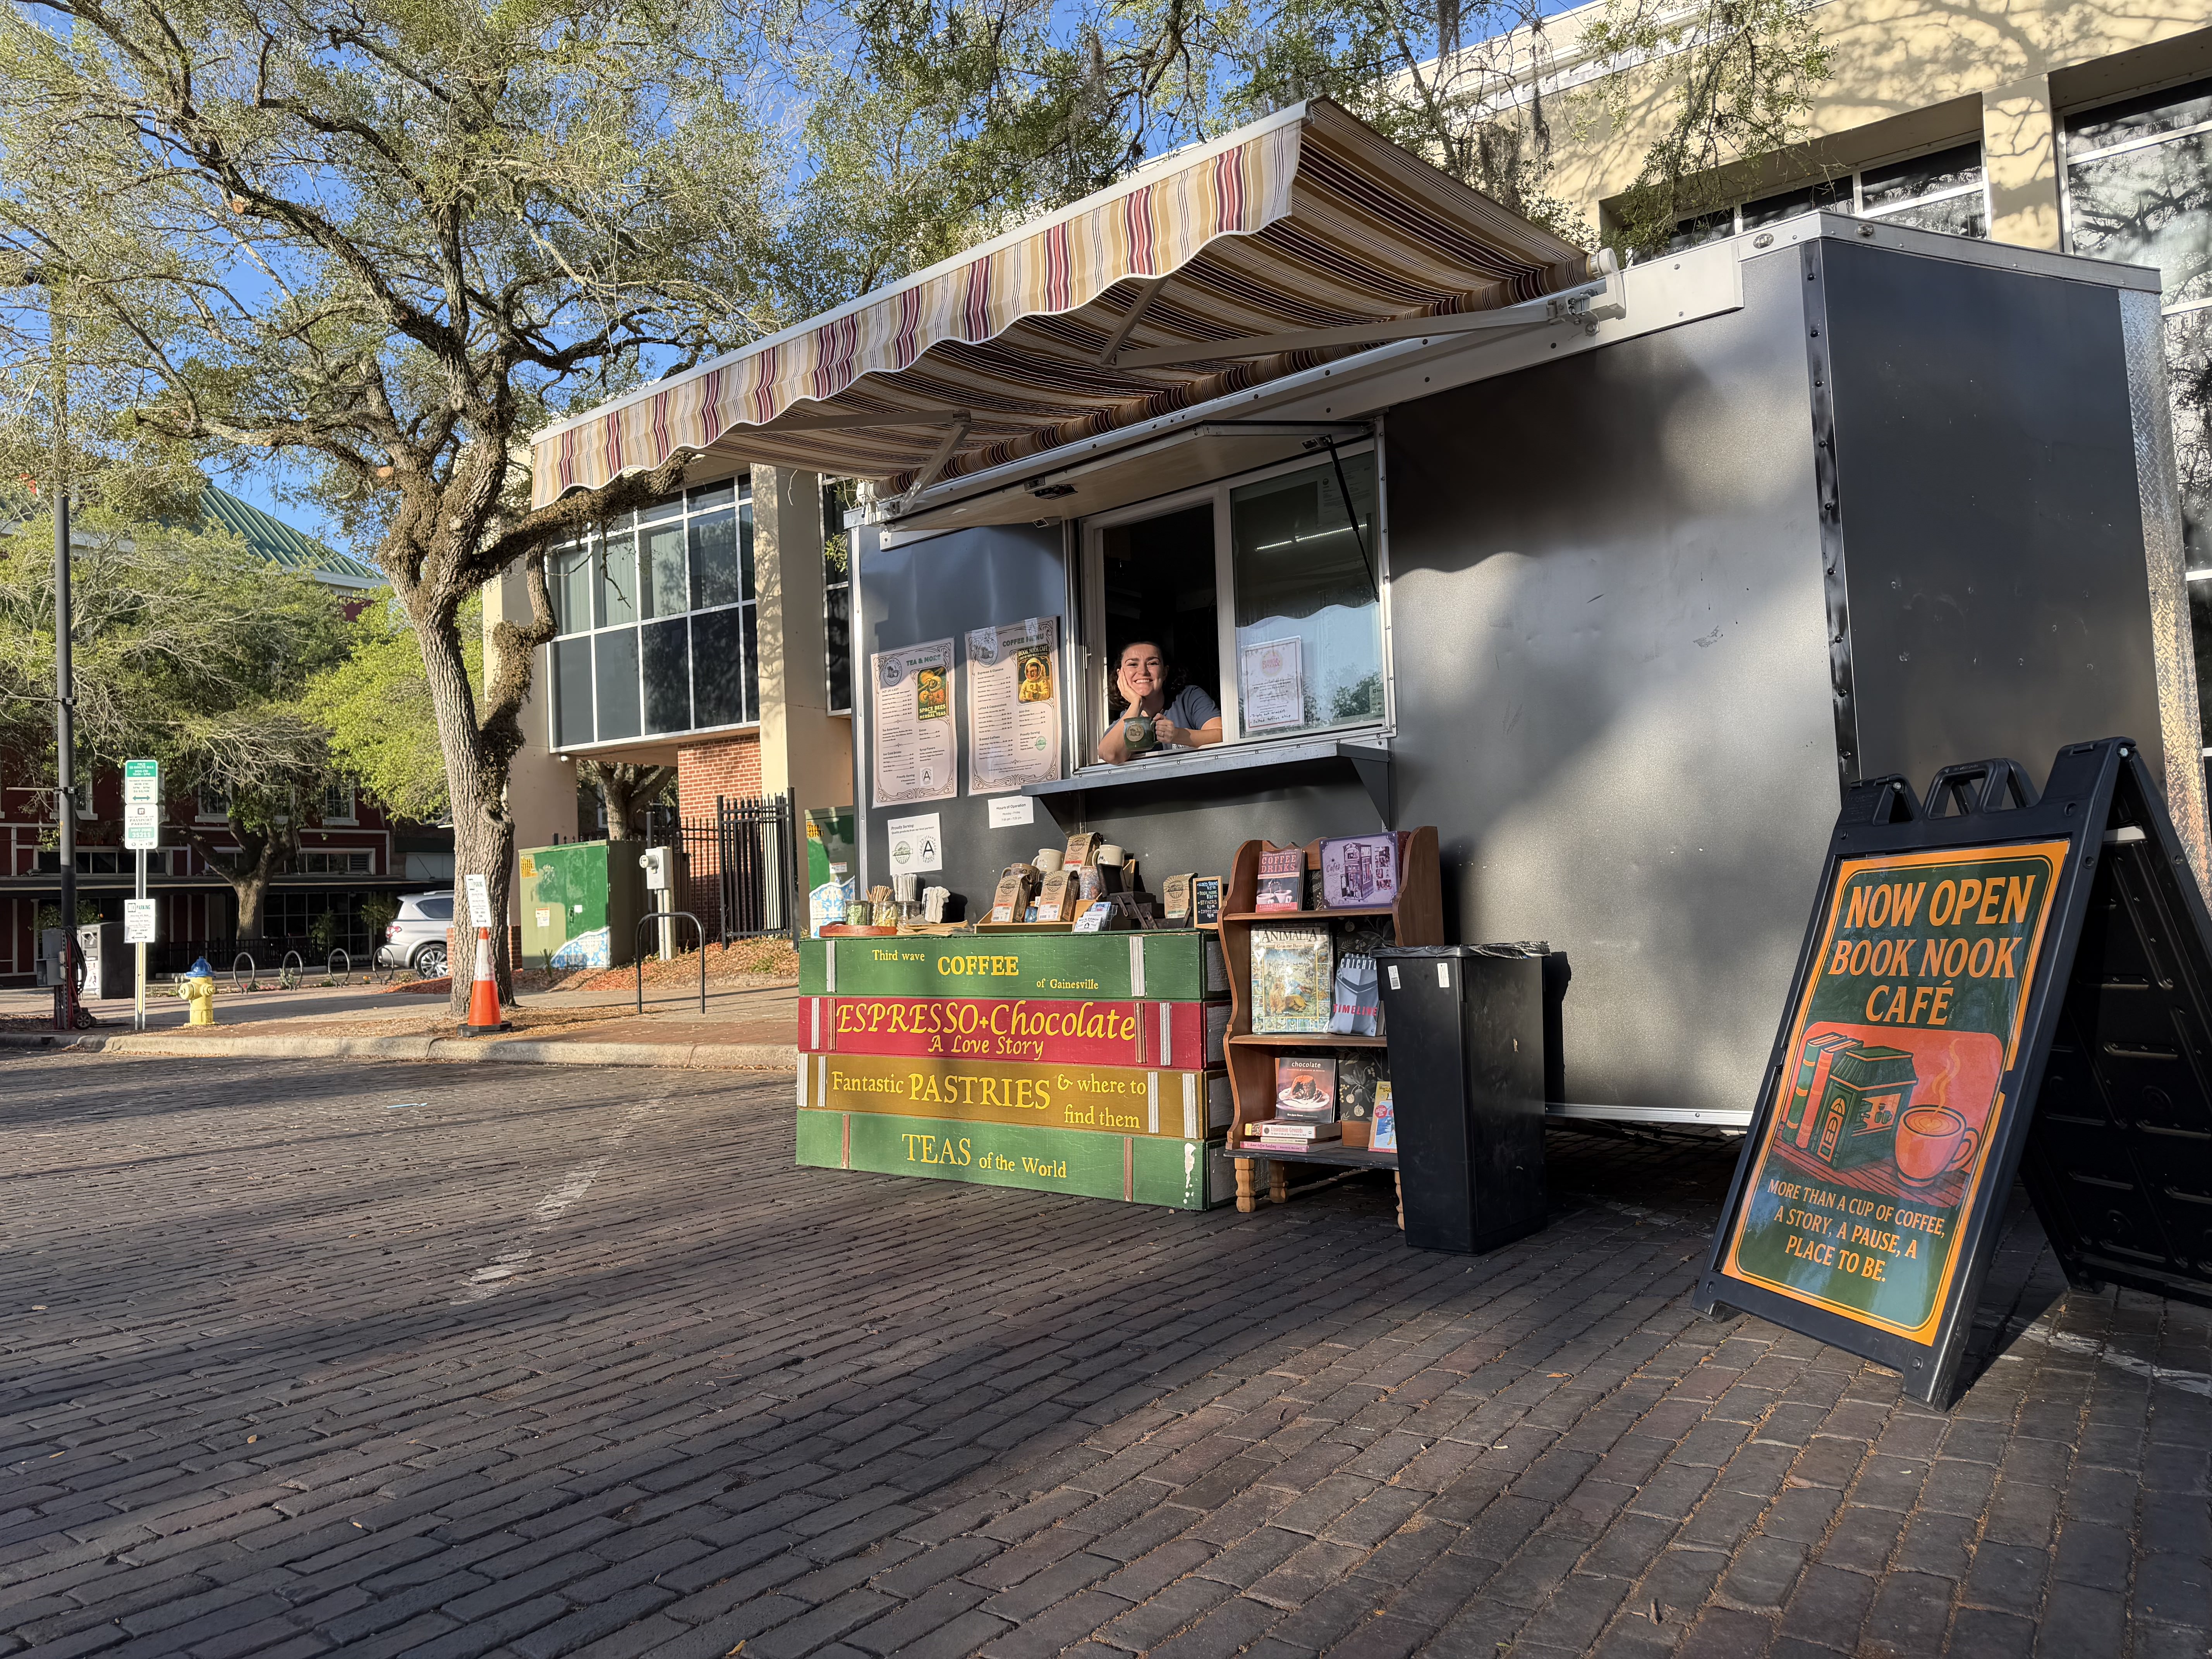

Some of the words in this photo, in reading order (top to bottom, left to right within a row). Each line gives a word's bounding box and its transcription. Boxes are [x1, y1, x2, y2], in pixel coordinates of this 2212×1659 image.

[1003, 638, 1024, 647] COFFEE
[924, 654, 941, 663] MORE
[924, 771, 931, 781] A
[923, 840, 934, 857] A
[1261, 864, 1295, 873] DRINKS
[1262, 855, 1296, 864] COFFEE
[1844, 882, 1927, 929] NOW
[1929, 875, 2036, 926] OPEN
[1262, 928, 1317, 943] ANIMALIA
[872, 950, 898, 961] Third
[902, 952, 925, 961] wave
[1340, 958, 1376, 970] CRICHTO
[1828, 939, 1917, 976] BOOK
[1918, 937, 2023, 979] NOOK
[938, 956, 1019, 976] COFFEE
[1036, 979, 1046, 988] of
[1050, 979, 1099, 990] Gainesville
[1333, 1003, 1378, 1016] TIMELINE
[1865, 980, 1954, 1025] CAFÉ
[836, 1002, 979, 1034] ESPRESSO
[991, 1000, 1135, 1041] Chocolate
[927, 1035, 943, 1052] A
[951, 1035, 989, 1053] Love
[996, 1036, 1044, 1061] Story
[831, 1071, 904, 1094] Fantastic
[908, 1073, 1051, 1109] PASTRIES
[1057, 1073, 1073, 1091] &
[1077, 1073, 1126, 1095] where
[1130, 1080, 1146, 1095] to
[1064, 1104, 1095, 1125] find
[1099, 1107, 1140, 1128] them
[902, 1133, 971, 1166] TEAS
[979, 1152, 993, 1169] of
[995, 1154, 1015, 1171] the
[1021, 1157, 1067, 1178] World
[1767, 1179, 1801, 1200] MORE
[1803, 1187, 1836, 1208] THAN
[1836, 1195, 1846, 1211] A
[1849, 1197, 1875, 1219] CUP
[1875, 1204, 1895, 1223] OF
[1894, 1209, 1946, 1238] COFFEE,
[1773, 1205, 1783, 1222] A
[1786, 1208, 1832, 1238] STORY,
[1836, 1222, 1847, 1240] A
[1851, 1224, 1901, 1258] PAUSE,
[1905, 1239, 1917, 1259] A
[1785, 1235, 1836, 1266] PLACE
[1838, 1249, 1860, 1273] TO
[1861, 1257, 1886, 1282] BE.
